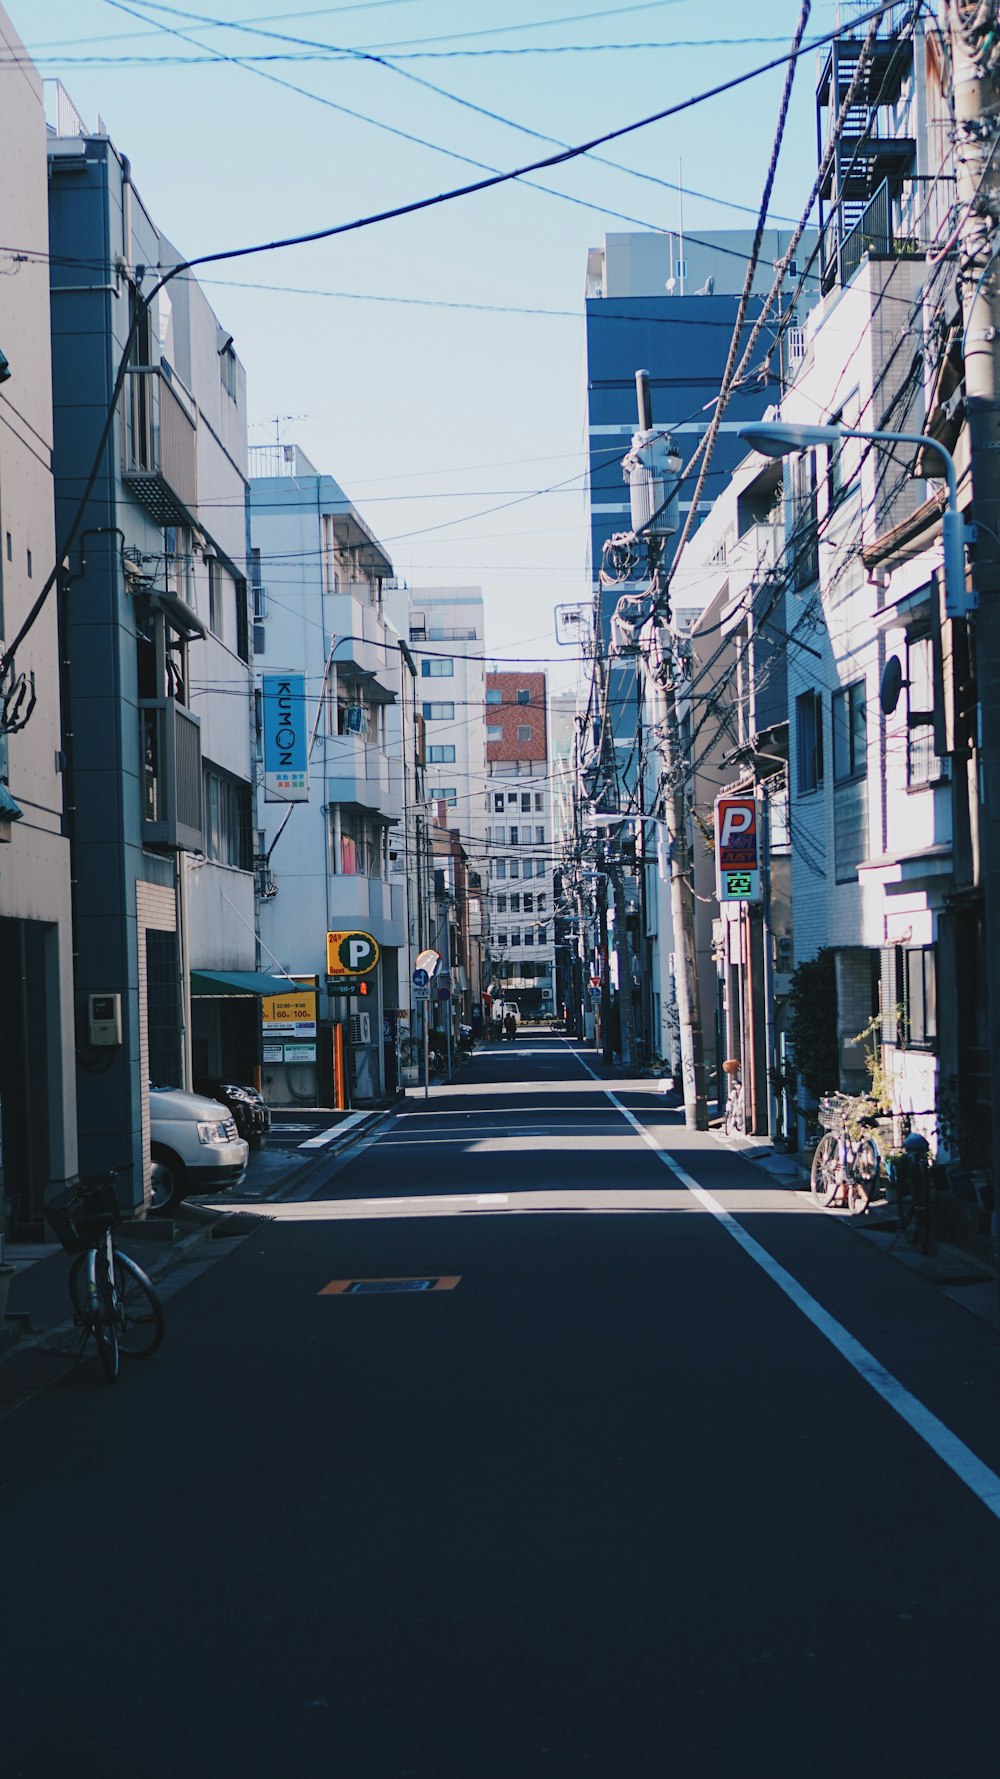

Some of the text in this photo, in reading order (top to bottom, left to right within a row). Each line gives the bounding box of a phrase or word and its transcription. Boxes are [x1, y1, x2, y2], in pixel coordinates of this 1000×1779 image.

[276, 683, 295, 765] KUMON
[720, 807, 752, 846] P
[721, 852, 753, 862] JUST
[727, 872, 751, 897] 空
[349, 940, 370, 967] P
